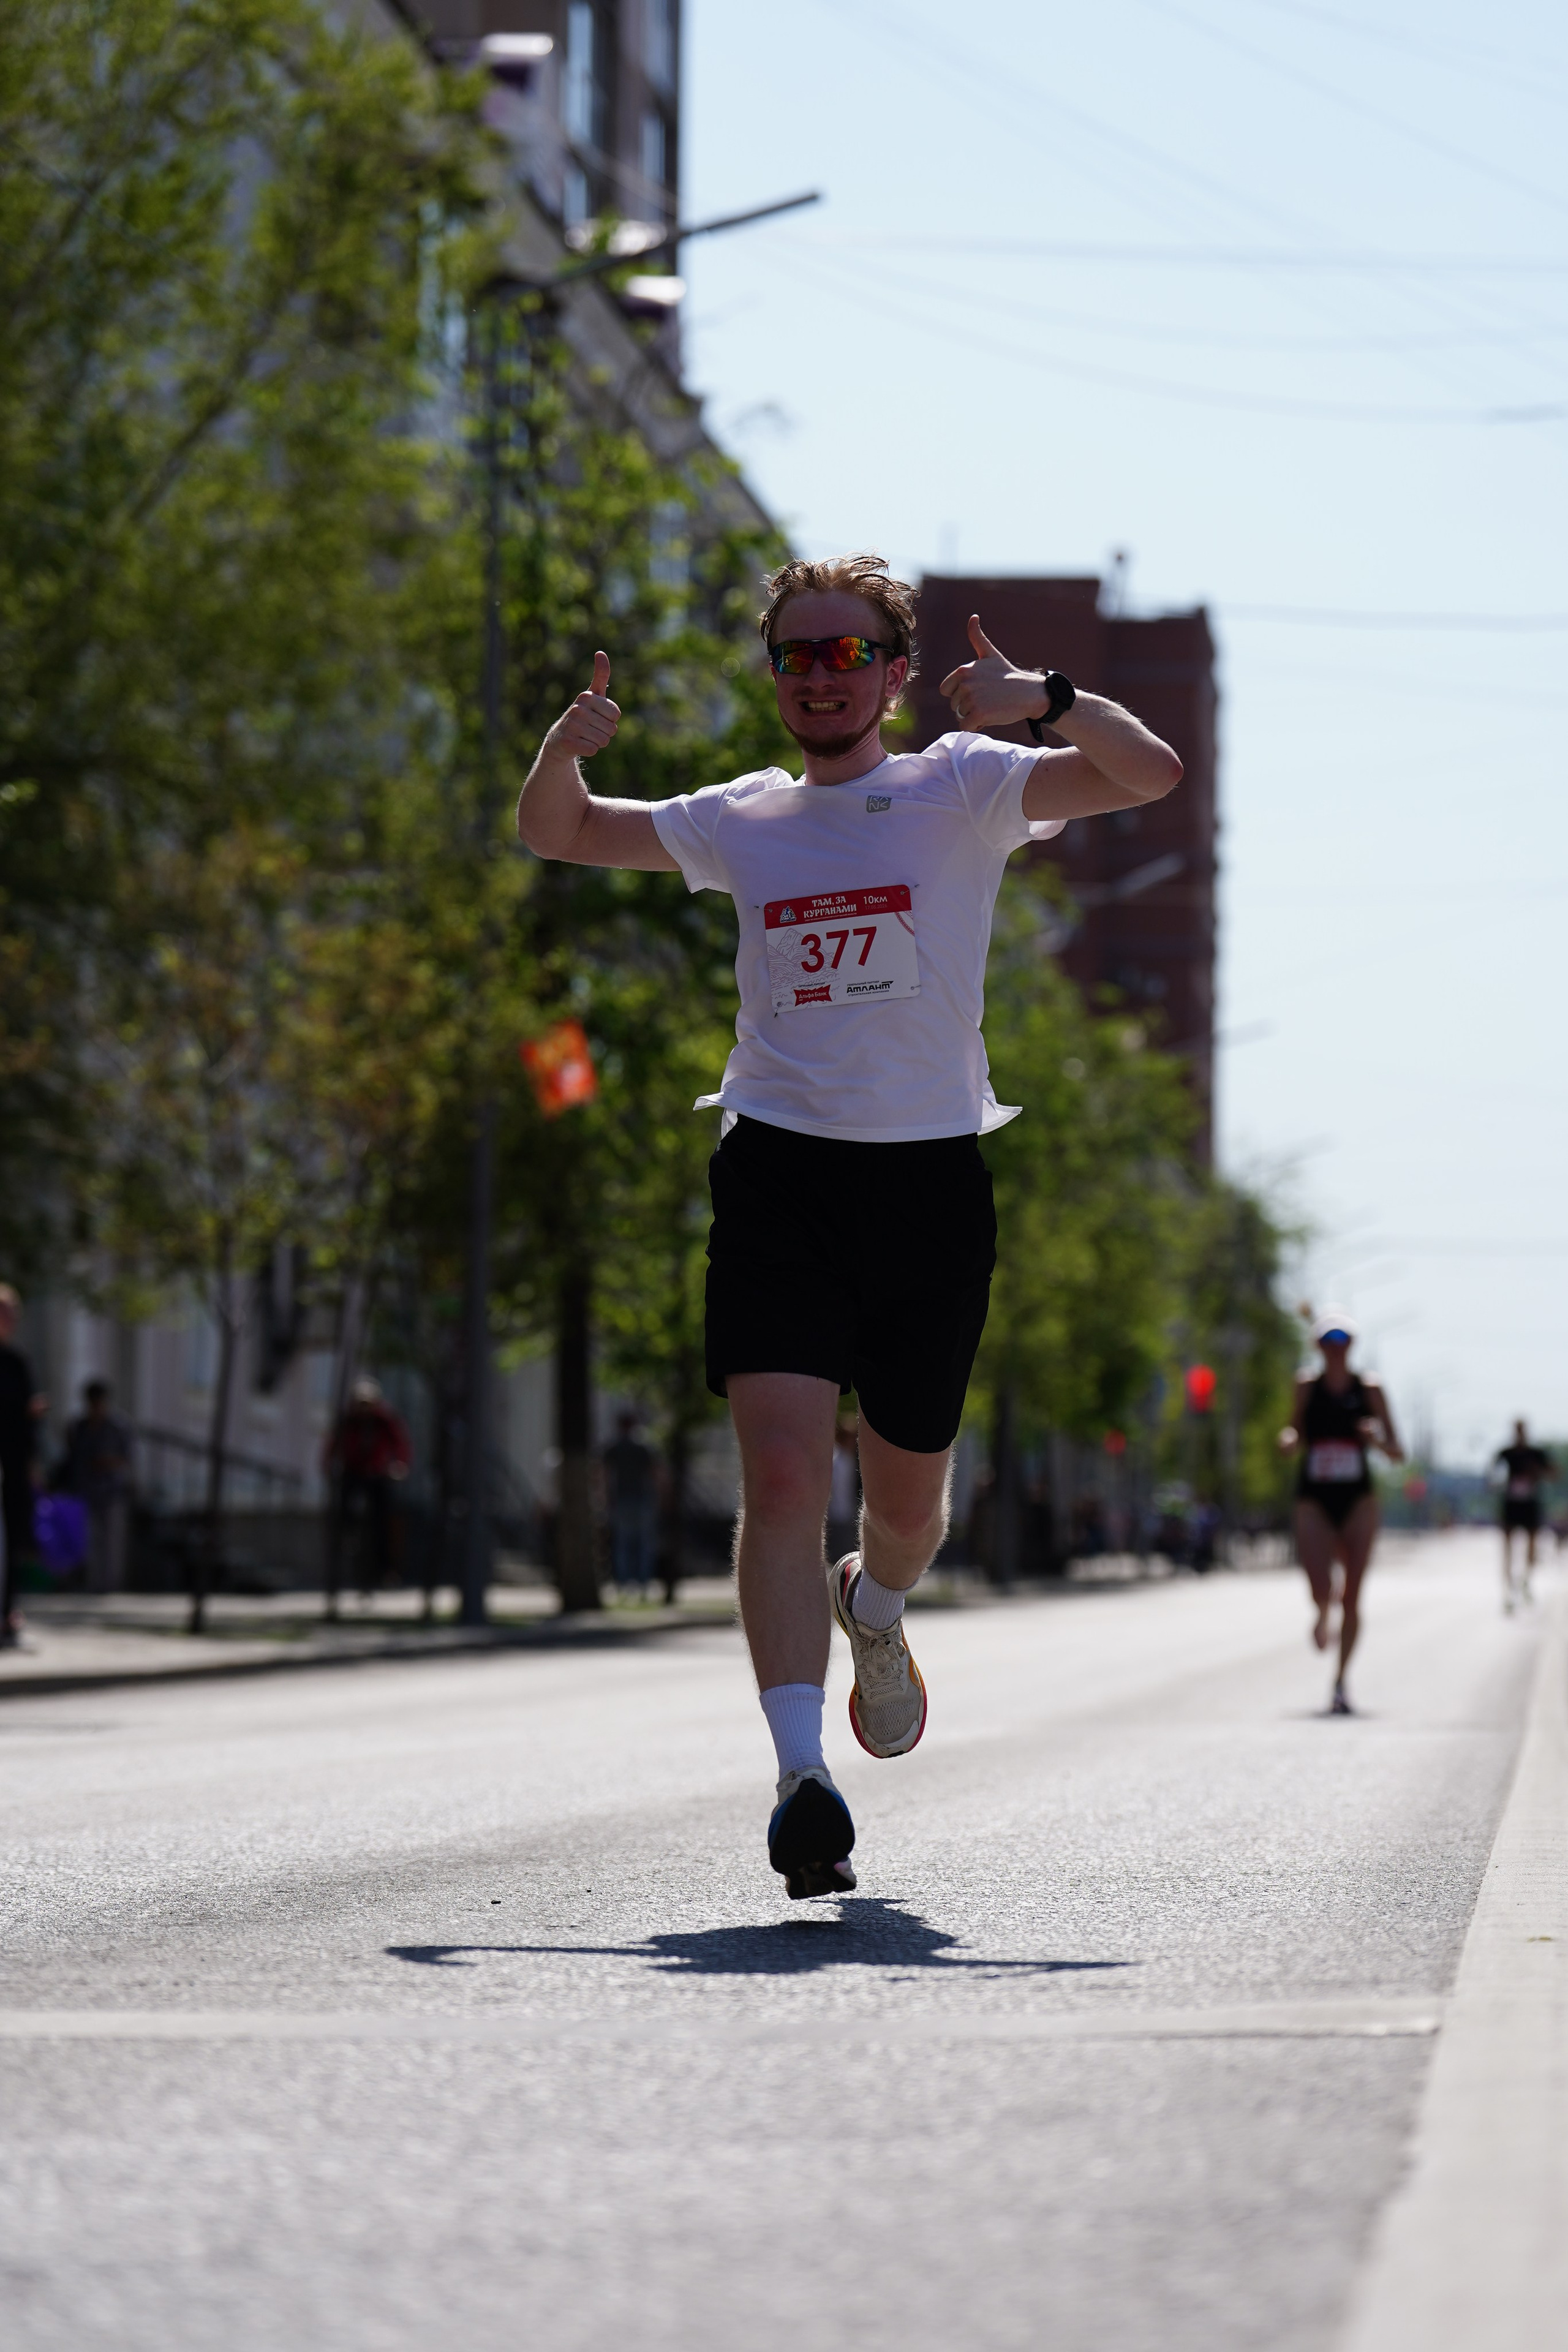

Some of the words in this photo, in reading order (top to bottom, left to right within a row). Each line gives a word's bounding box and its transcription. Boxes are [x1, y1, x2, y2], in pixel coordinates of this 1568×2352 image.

[812, 897, 834, 907] ТАМ,
[835, 895, 846, 904] ЗА
[803, 904, 857, 918] КУРГАНАМИ
[801, 926, 877, 973] 377
